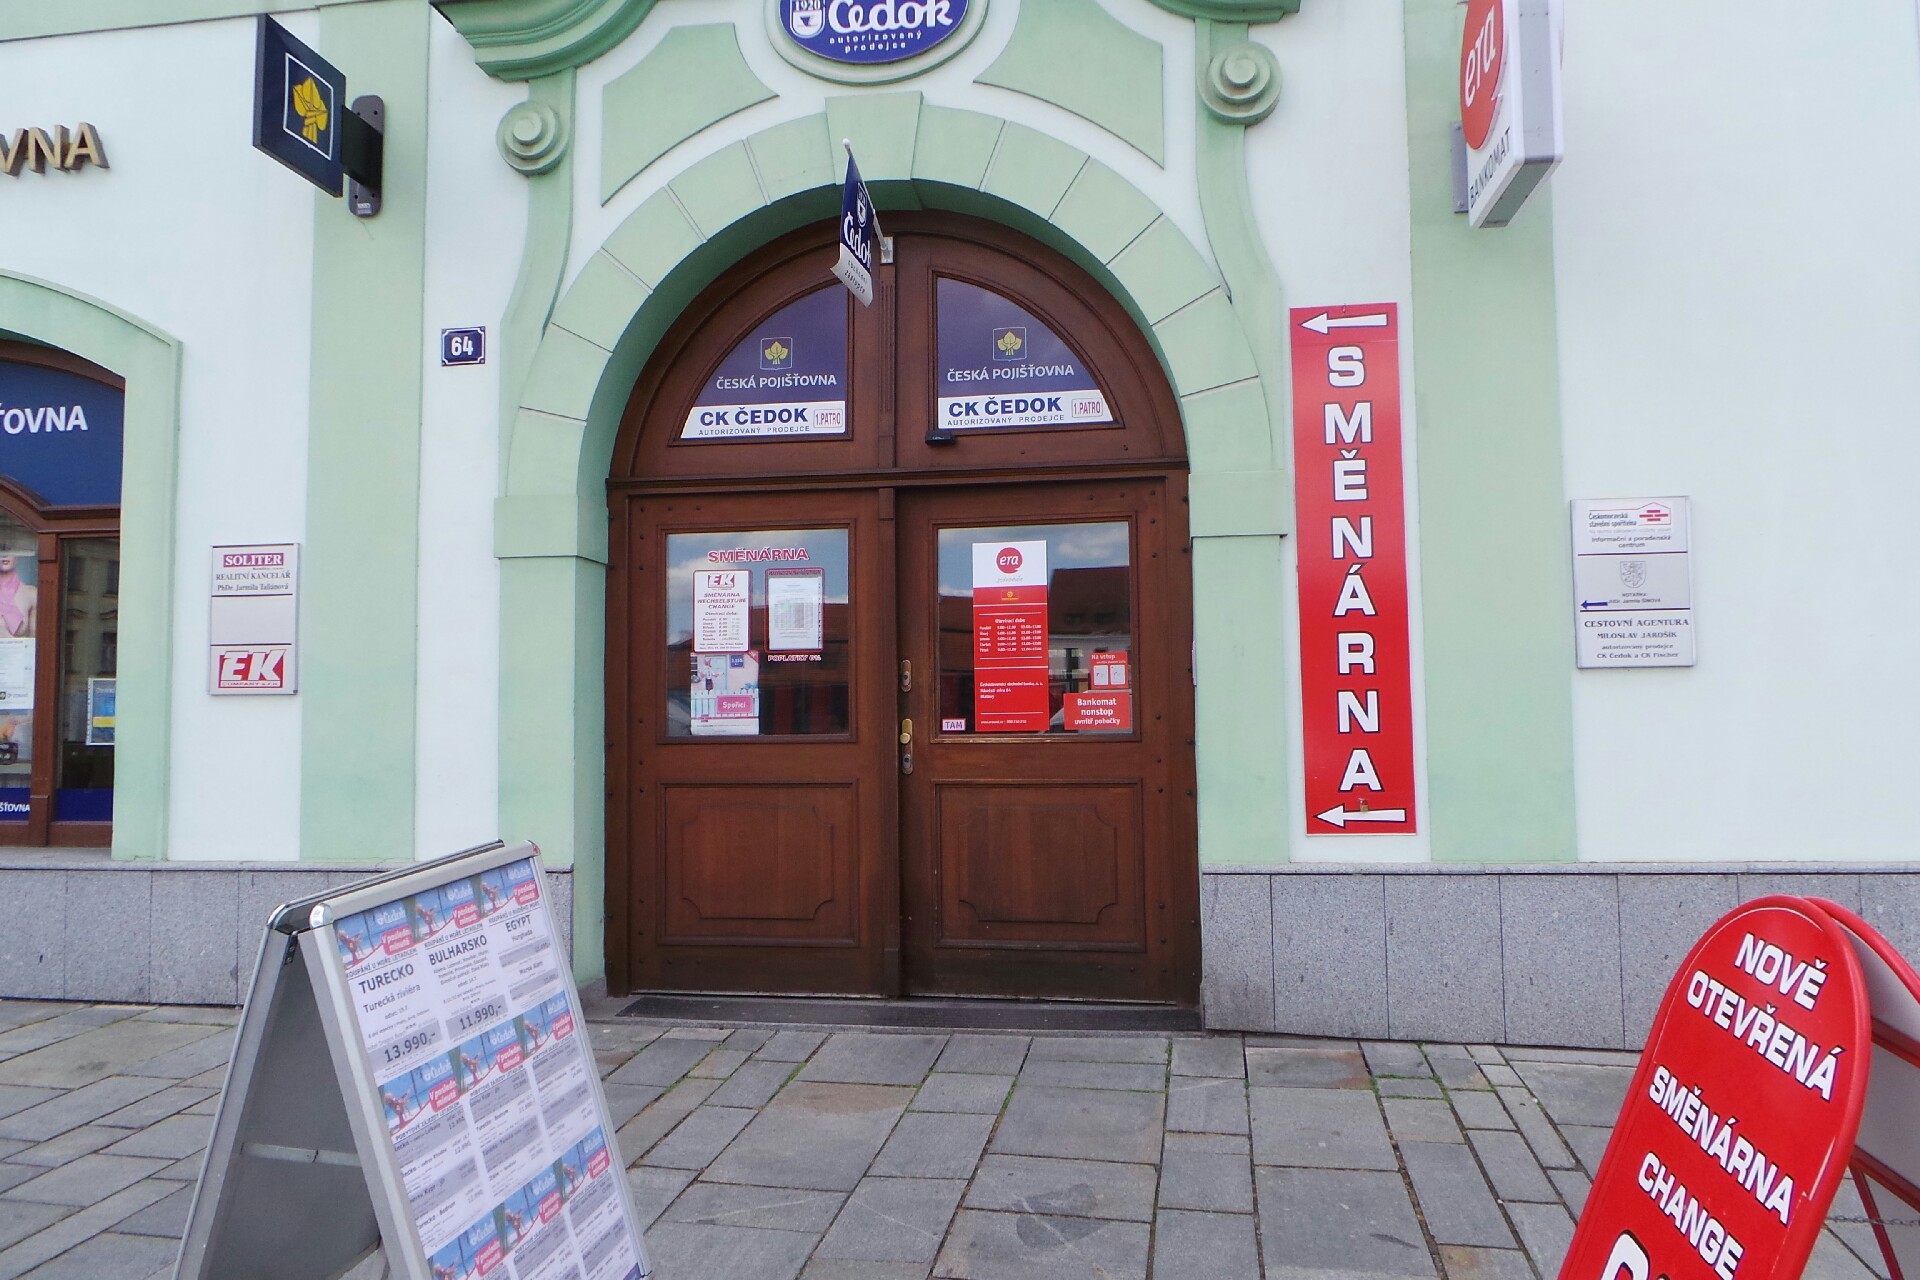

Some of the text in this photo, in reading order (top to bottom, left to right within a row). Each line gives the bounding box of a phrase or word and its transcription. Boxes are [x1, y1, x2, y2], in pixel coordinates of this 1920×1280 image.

[830, 30, 922, 44] autorizovaný
[845, 42, 906, 53] prodejce
[1465, 3, 1496, 108] era
[1469, 127, 1511, 209] BANKOMAT
[450, 336, 474, 356] 64
[716, 373, 837, 390] ČESKÁ POJIŠŤOVNA
[947, 364, 1074, 382] ČESKÁ POJIŠŤOVNA
[948, 396, 1063, 417] CK ČEDOK
[1073, 400, 1101, 416] 1.PATRO
[700, 406, 808, 426] CK ČEDOK
[815, 411, 842, 426] 1.PATRO
[947, 415, 1065, 426] AUTORIZOVANÝ PRODEJCE
[698, 425, 810, 436] AUTORIZOVANÝ PRODEJCE
[225, 554, 283, 567] SOLITER
[708, 547, 810, 563] SMĚNÁRNA
[1000, 555, 1019, 566] era
[216, 570, 291, 581] REALITNÍ KANCELÁŘ
[1322, 345, 1384, 792] SMĚNÁRNA
[707, 573, 736, 588] EK
[1584, 618, 1689, 628] CESTOVNÍ AGENTURA
[1641, 630, 1677, 639] JAROŠÍK
[219, 649, 287, 681] EK
[1077, 697, 1117, 706] Bankomat
[1081, 707, 1114, 717] nonstop
[945, 721, 963, 729] TAM
[1095, 718, 1121, 726] pobočky
[505, 914, 531, 933] EGYPT
[428, 934, 488, 966] BULHARSKO
[358, 963, 415, 994] TURECKO
[1734, 931, 1829, 1011] NOVĚ
[363, 991, 396, 1014] Turecká
[396, 983, 421, 1001] riviéra
[459, 1003, 502, 1031] 11.990,-
[1686, 969, 1846, 1102] OTEVŘENÁ
[384, 1031, 436, 1063] 13.990,-
[1648, 1063, 1795, 1226] SMĚNÁRNA
[1637, 1150, 1745, 1280] CHANGE
